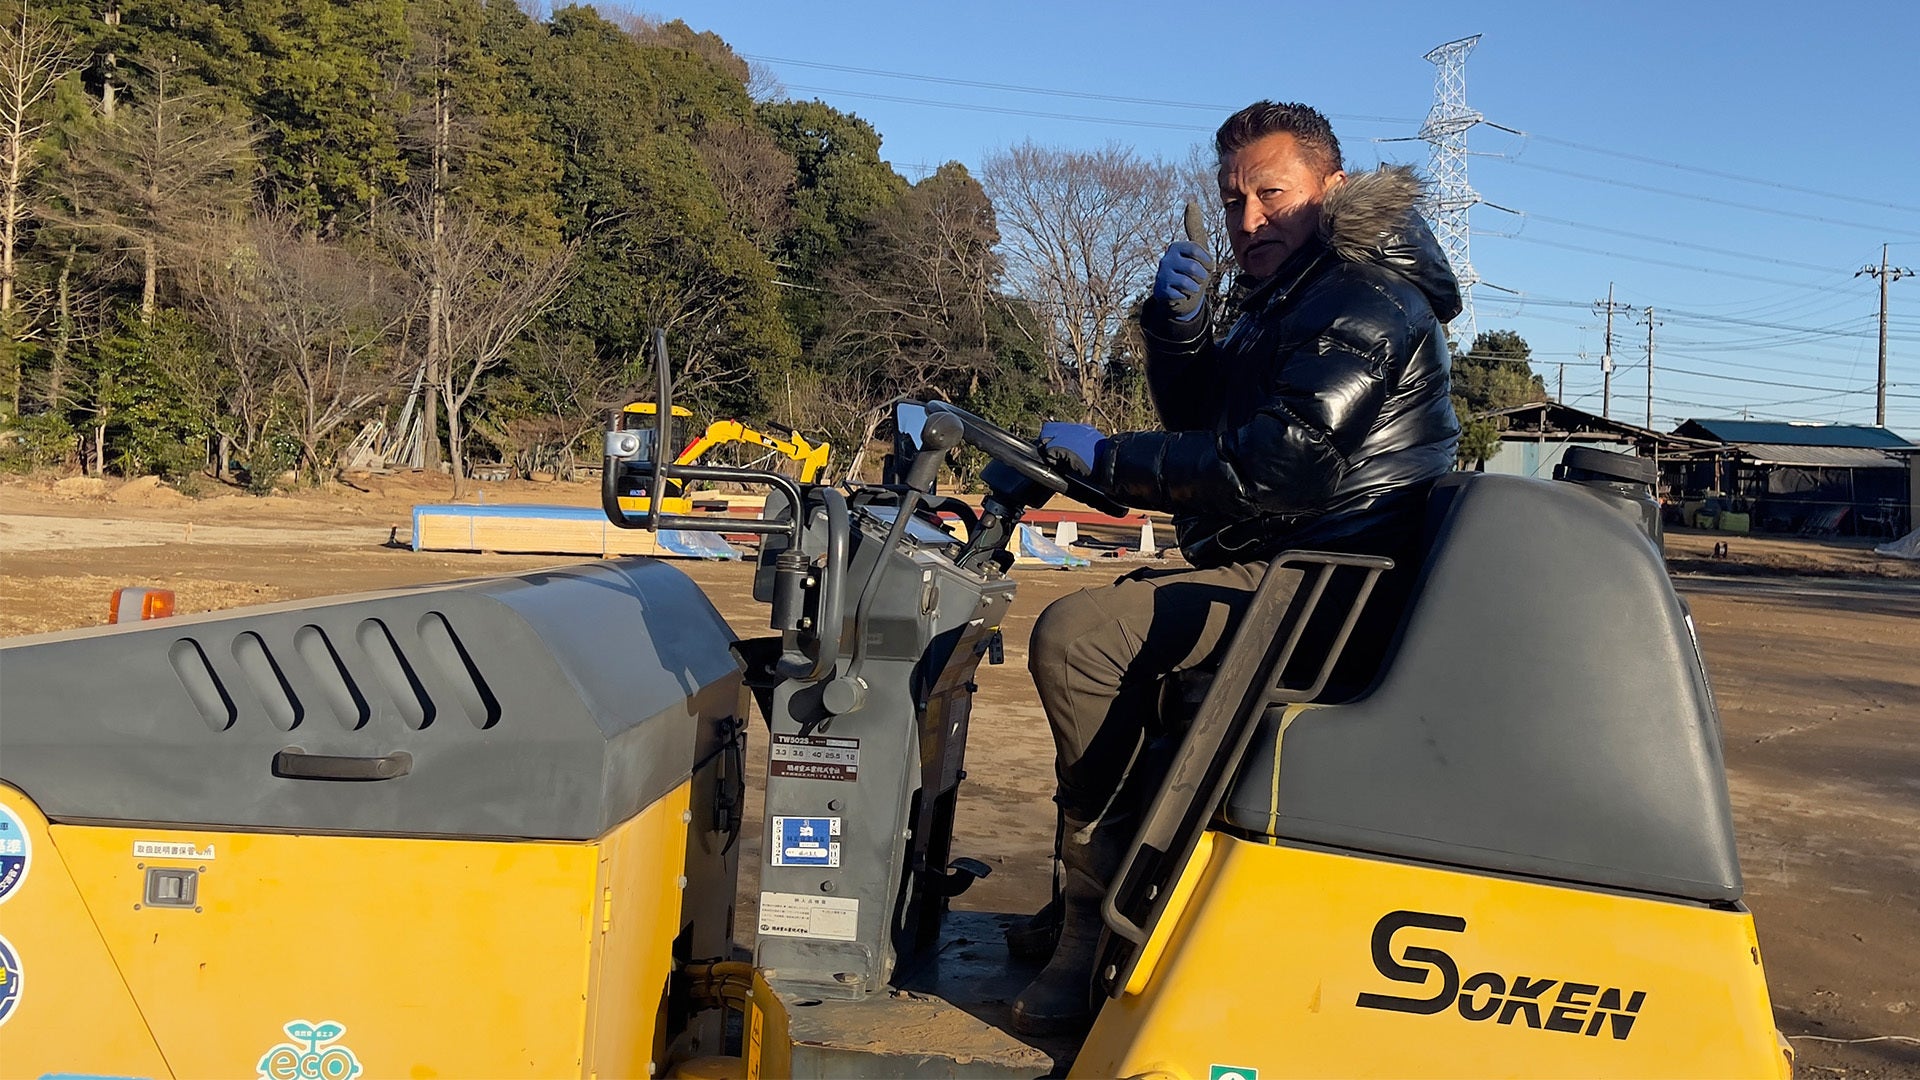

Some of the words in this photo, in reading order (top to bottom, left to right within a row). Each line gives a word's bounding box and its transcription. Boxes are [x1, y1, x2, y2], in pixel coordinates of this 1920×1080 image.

[137, 845, 212, 856] 取扱説明書保管所
[1355, 909, 1647, 1040] SOKEN
[268, 1051, 352, 1080] eco
